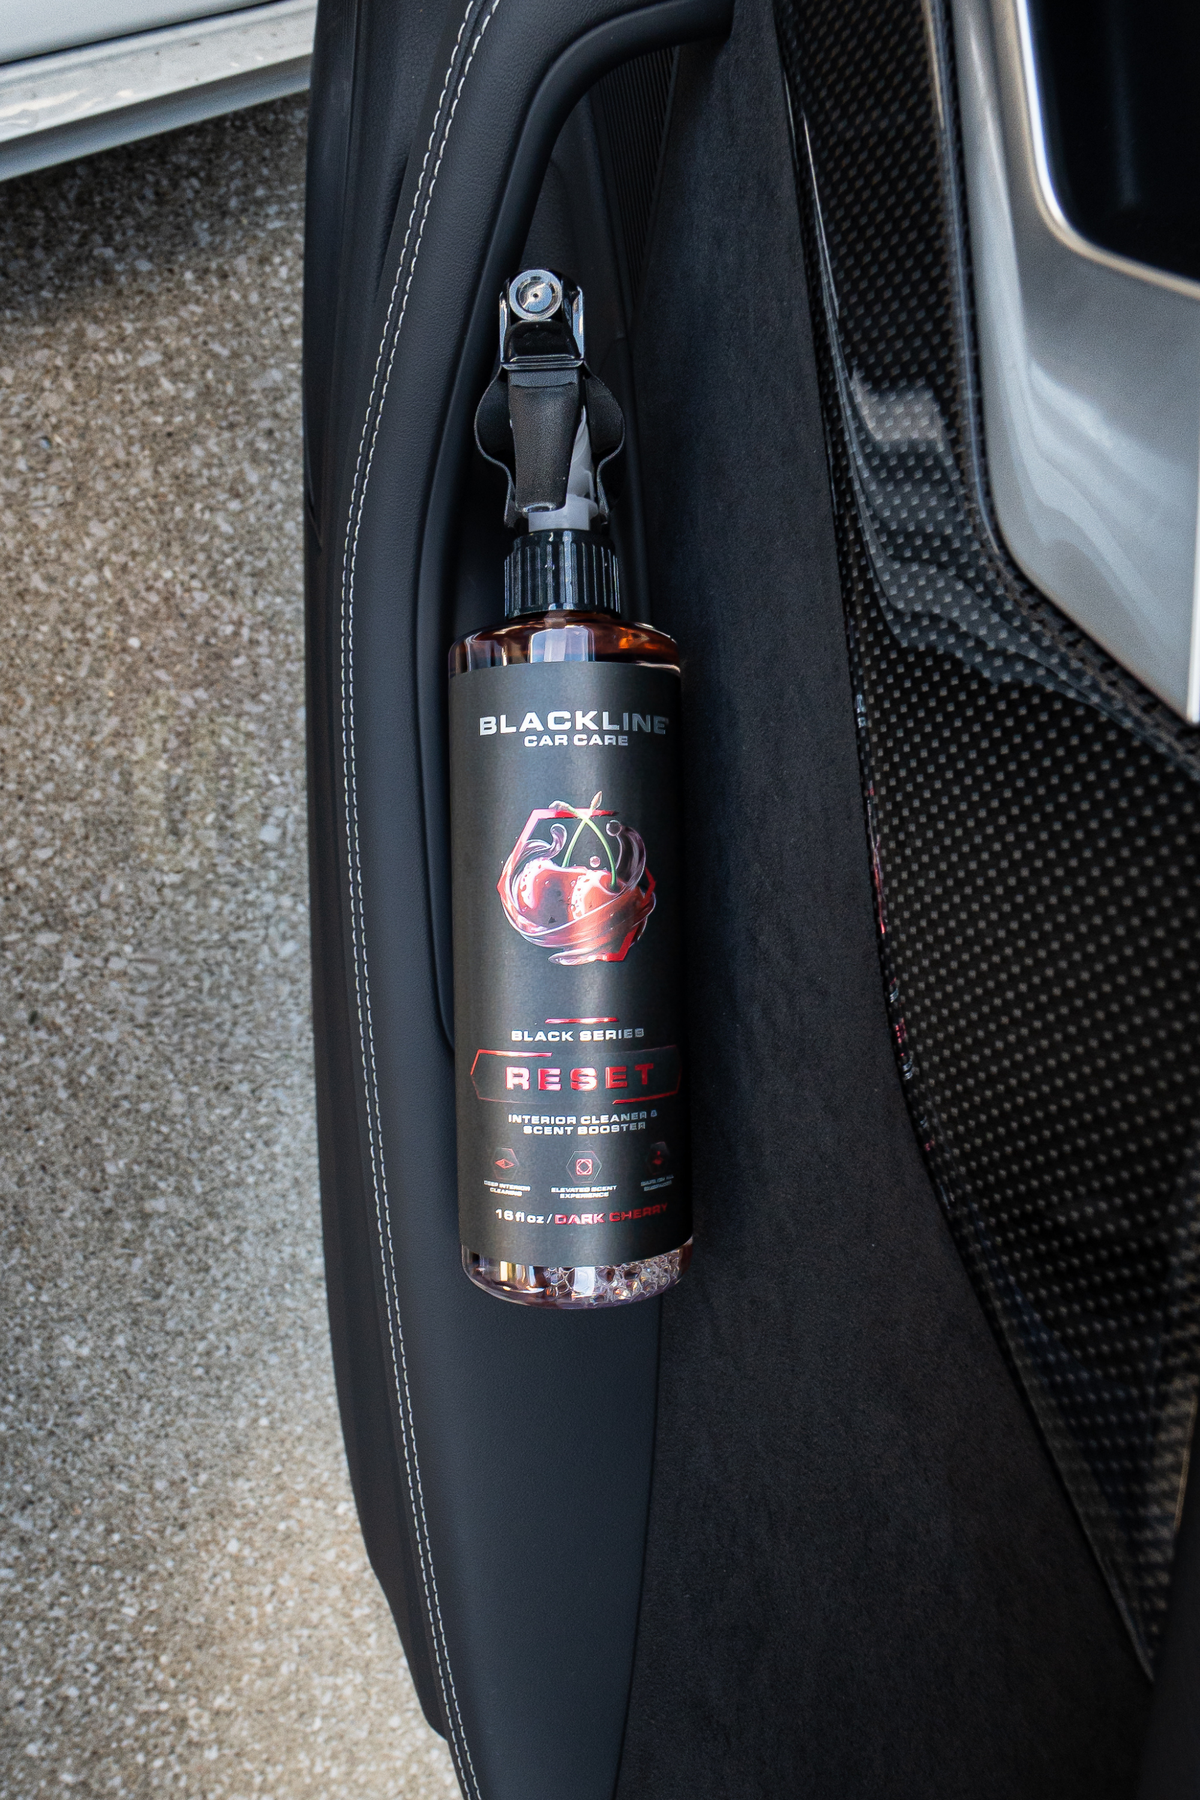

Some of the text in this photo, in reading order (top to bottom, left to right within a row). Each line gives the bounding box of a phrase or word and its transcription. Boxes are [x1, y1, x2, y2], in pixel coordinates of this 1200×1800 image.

[479, 710, 667, 736] BLACKLINE
[524, 733, 629, 747] CAR CARE
[511, 1028, 645, 1042] BLACK SERIES
[505, 1063, 654, 1092] RESET
[508, 1114, 576, 1125] INTERIOR
[580, 1111, 647, 1124] CLEANER
[523, 1121, 646, 1136] SCENT BOOSTER
[554, 1213, 604, 1225] DARK
[609, 1203, 668, 1222] CHERRY
